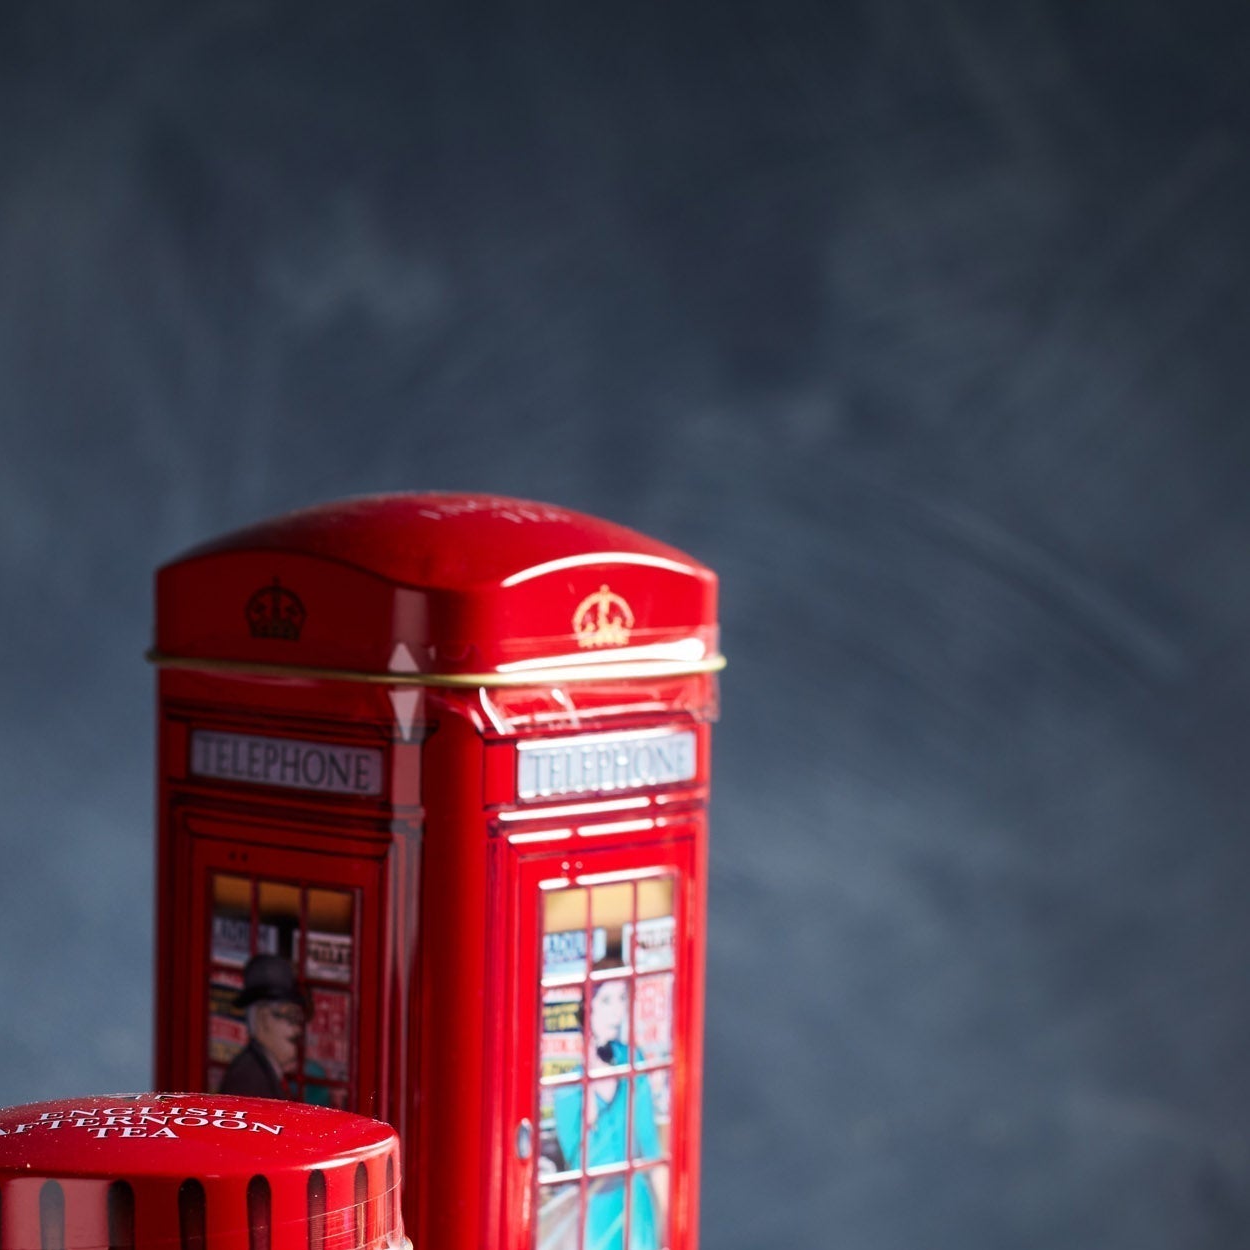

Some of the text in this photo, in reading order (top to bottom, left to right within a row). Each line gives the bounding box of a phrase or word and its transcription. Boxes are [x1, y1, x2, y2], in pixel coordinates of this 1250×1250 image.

[197, 735, 371, 791] TELEPHONE
[526, 738, 692, 789] TELEPHONE
[38, 1106, 248, 1121] ENGLISH
[87, 1126, 179, 1139] TEA
